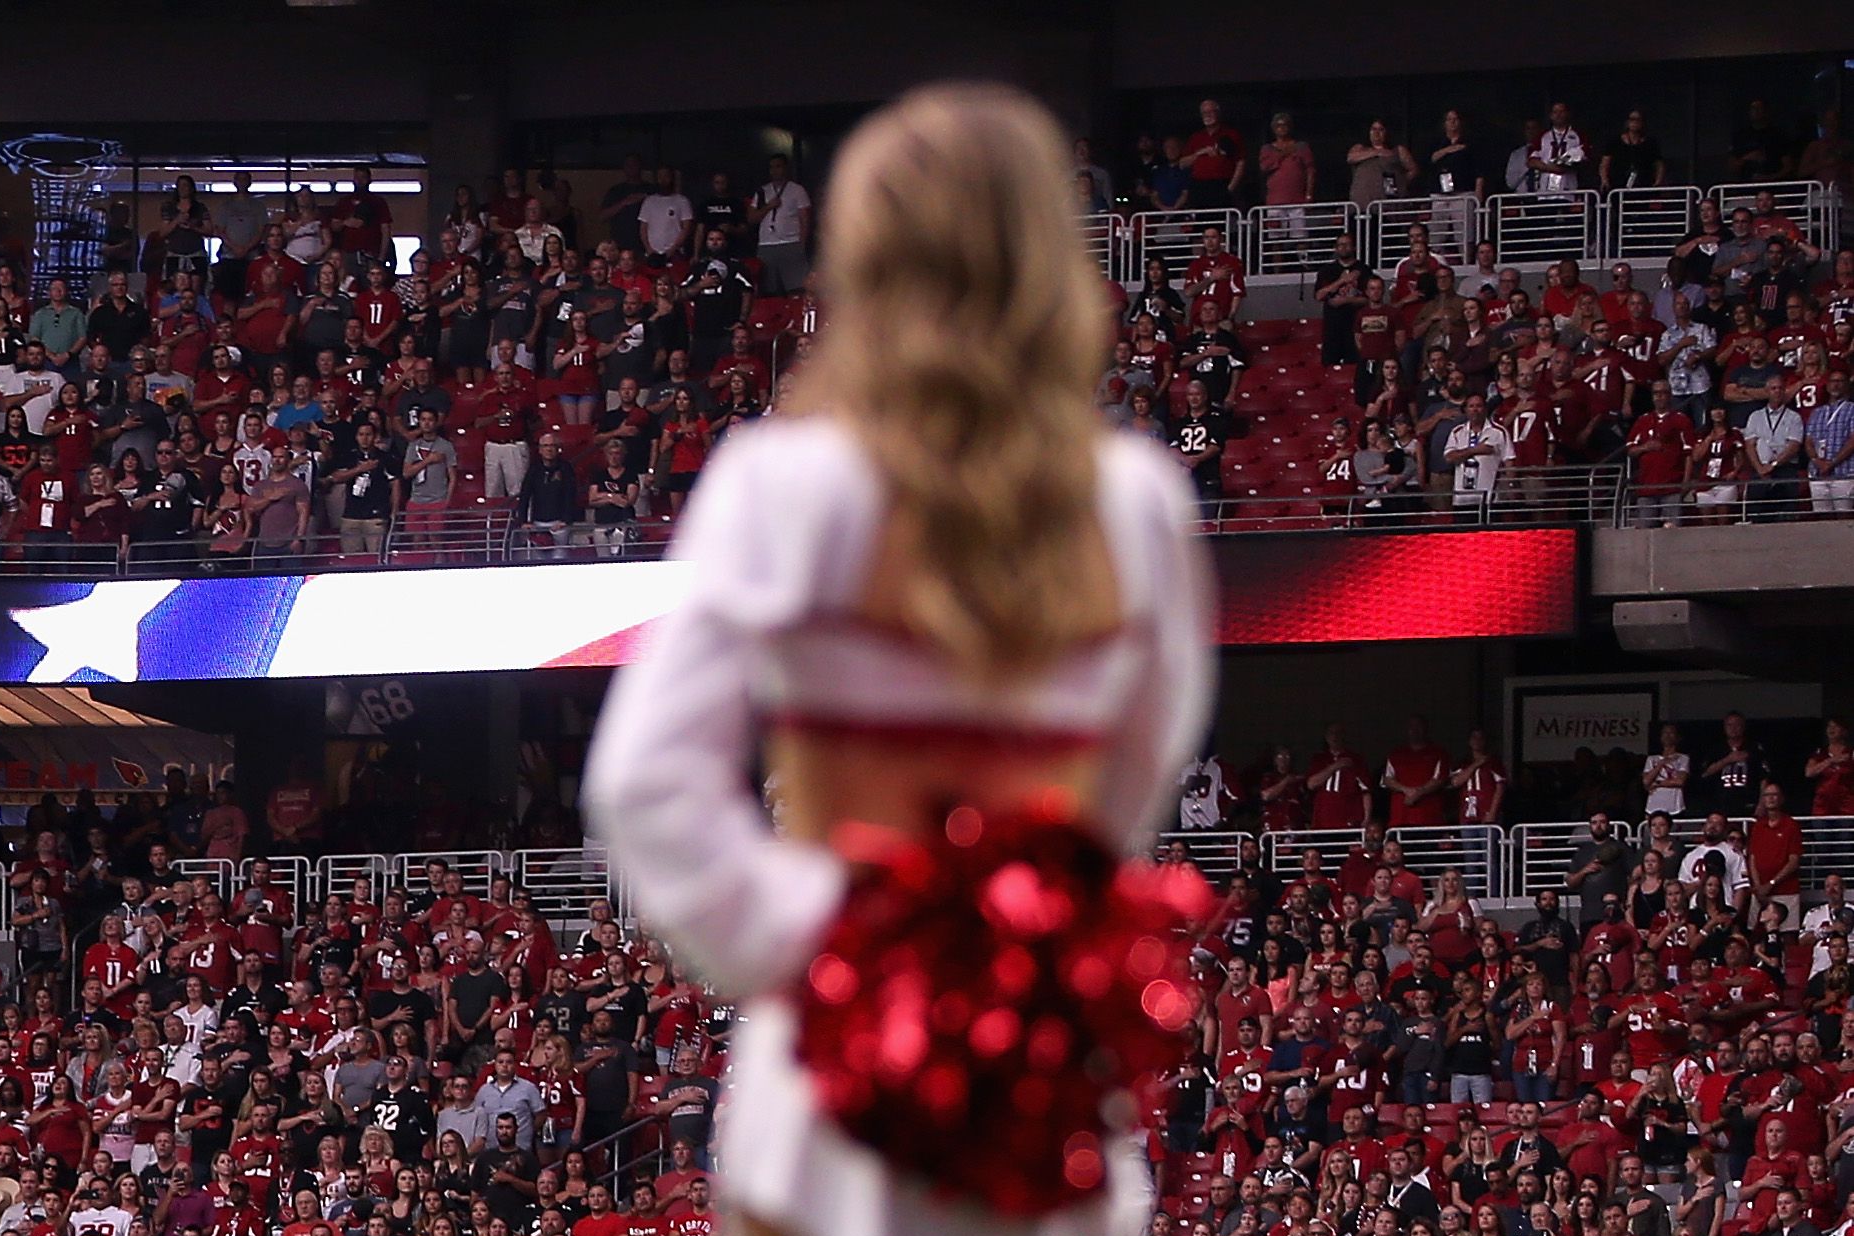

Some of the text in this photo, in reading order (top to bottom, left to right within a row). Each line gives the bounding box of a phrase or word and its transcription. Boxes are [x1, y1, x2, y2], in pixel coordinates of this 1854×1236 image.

[368, 304, 383, 324] 11
[1179, 427, 1207, 452] 32
[237, 460, 262, 486] 13
[358, 681, 412, 725] 68
[1565, 718, 1641, 738] FITNESS
[106, 961, 122, 986] 11
[371, 1104, 398, 1131] 32
